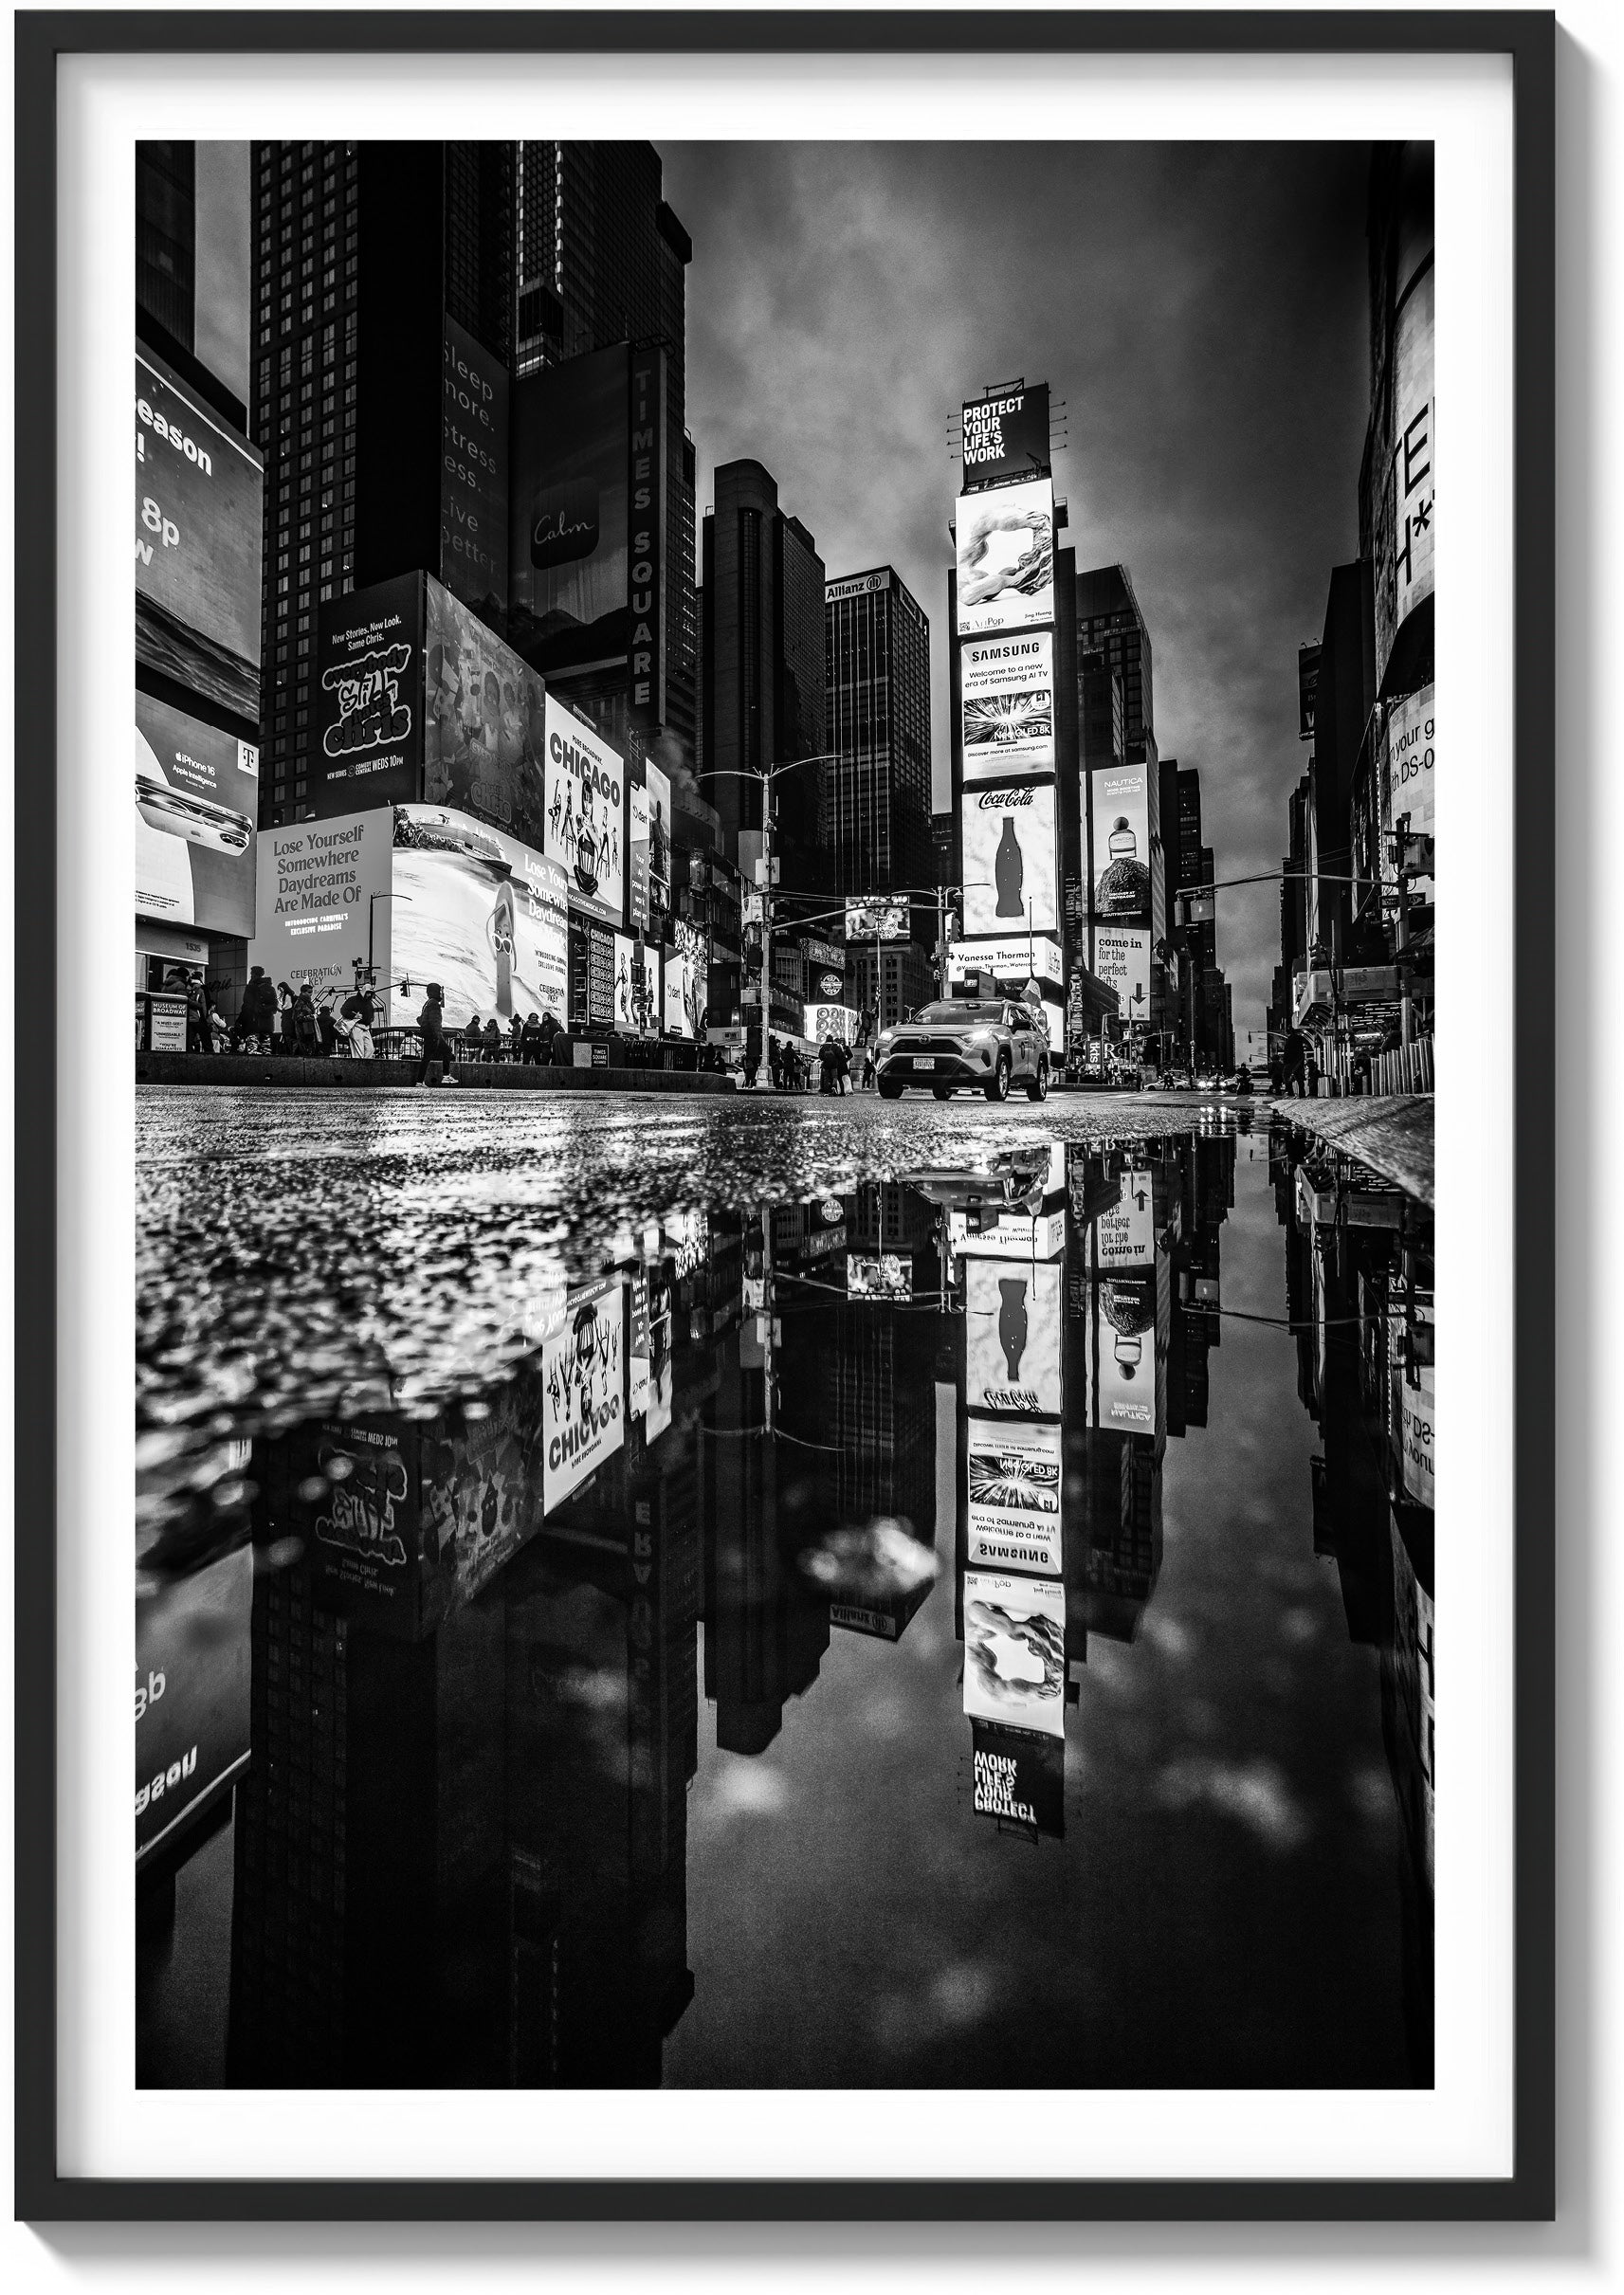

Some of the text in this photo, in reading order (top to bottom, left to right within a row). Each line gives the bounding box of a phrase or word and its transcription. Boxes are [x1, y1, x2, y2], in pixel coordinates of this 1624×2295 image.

[963, 395, 1024, 424] PROTECT
[963, 416, 1000, 436] YOUR
[963, 430, 1003, 451] LIFE'S
[963, 443, 1005, 465] WORK
[141, 497, 180, 548] 8p
[443, 495, 479, 532] ive
[534, 510, 595, 545] Calm
[632, 369, 654, 705] TIMES SQUARE
[827, 582, 865, 600] Allianz
[332, 614, 402, 645] New Stories. New Look.
[348, 631, 385, 651] Same Chris.
[972, 642, 1040, 662] SAMSUNG
[969, 668, 1006, 679] Welcome
[990, 674, 1027, 684] Samsung
[1039, 725, 1051, 735] 8K
[1012, 744, 1049, 753] samsung.com
[1396, 725, 1421, 761] your
[181, 753, 216, 776] iPhone 16
[372, 756, 389, 771] WEDS
[549, 732, 621, 808] CHICAGO
[173, 764, 188, 777] Apple
[189, 771, 217, 789] Intelligence
[1104, 776, 1143, 788] NAUTICA
[273, 824, 365, 856] Lose Yourself
[277, 849, 360, 875] Somewhere
[524, 853, 546, 881] Lose
[279, 869, 356, 895] Daydreams
[631, 878, 648, 894] poweed
[274, 884, 362, 914] Are Made Of
[284, 912, 349, 927] INTRODUCING CARNIVAL'S
[290, 922, 342, 936] EXCLUSIVE PARADISE
[1098, 938, 1142, 949] come in
[1098, 947, 1125, 960] for the
[958, 951, 1035, 962] Vanessa Thorman
[290, 964, 342, 979] CELEBRATION
[1098, 963, 1128, 977] perfect
[308, 975, 324, 986] KEY
